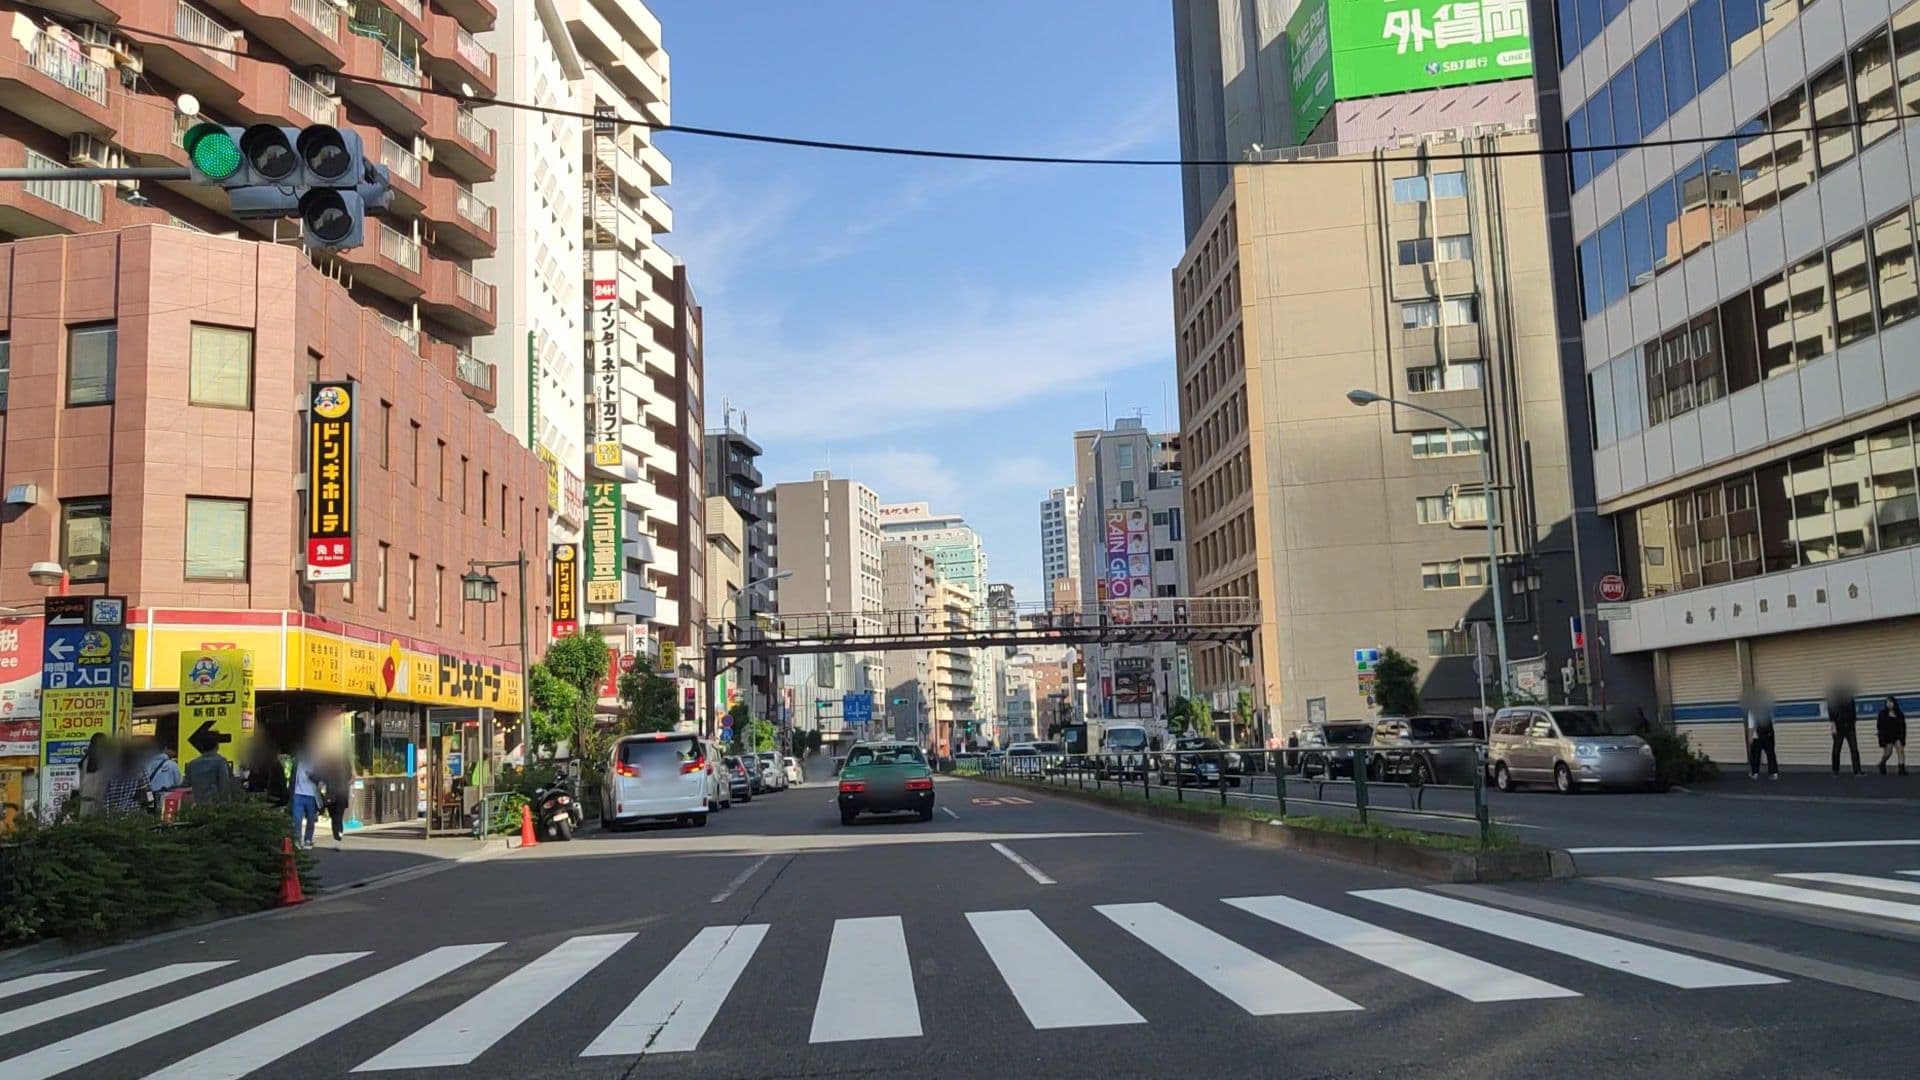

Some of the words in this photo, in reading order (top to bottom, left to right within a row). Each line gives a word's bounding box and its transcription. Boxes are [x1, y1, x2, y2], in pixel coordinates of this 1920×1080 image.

[595, 284, 615, 296] 24H
[601, 302, 616, 441] インターネットカフェ
[593, 484, 615, 496] 7F
[1108, 512, 1125, 552] RAIN
[75, 668, 111, 685] 入口
[52, 698, 105, 711] 1,700円
[194, 707, 227, 717] 新宿店
[52, 717, 103, 729] 1,300円
